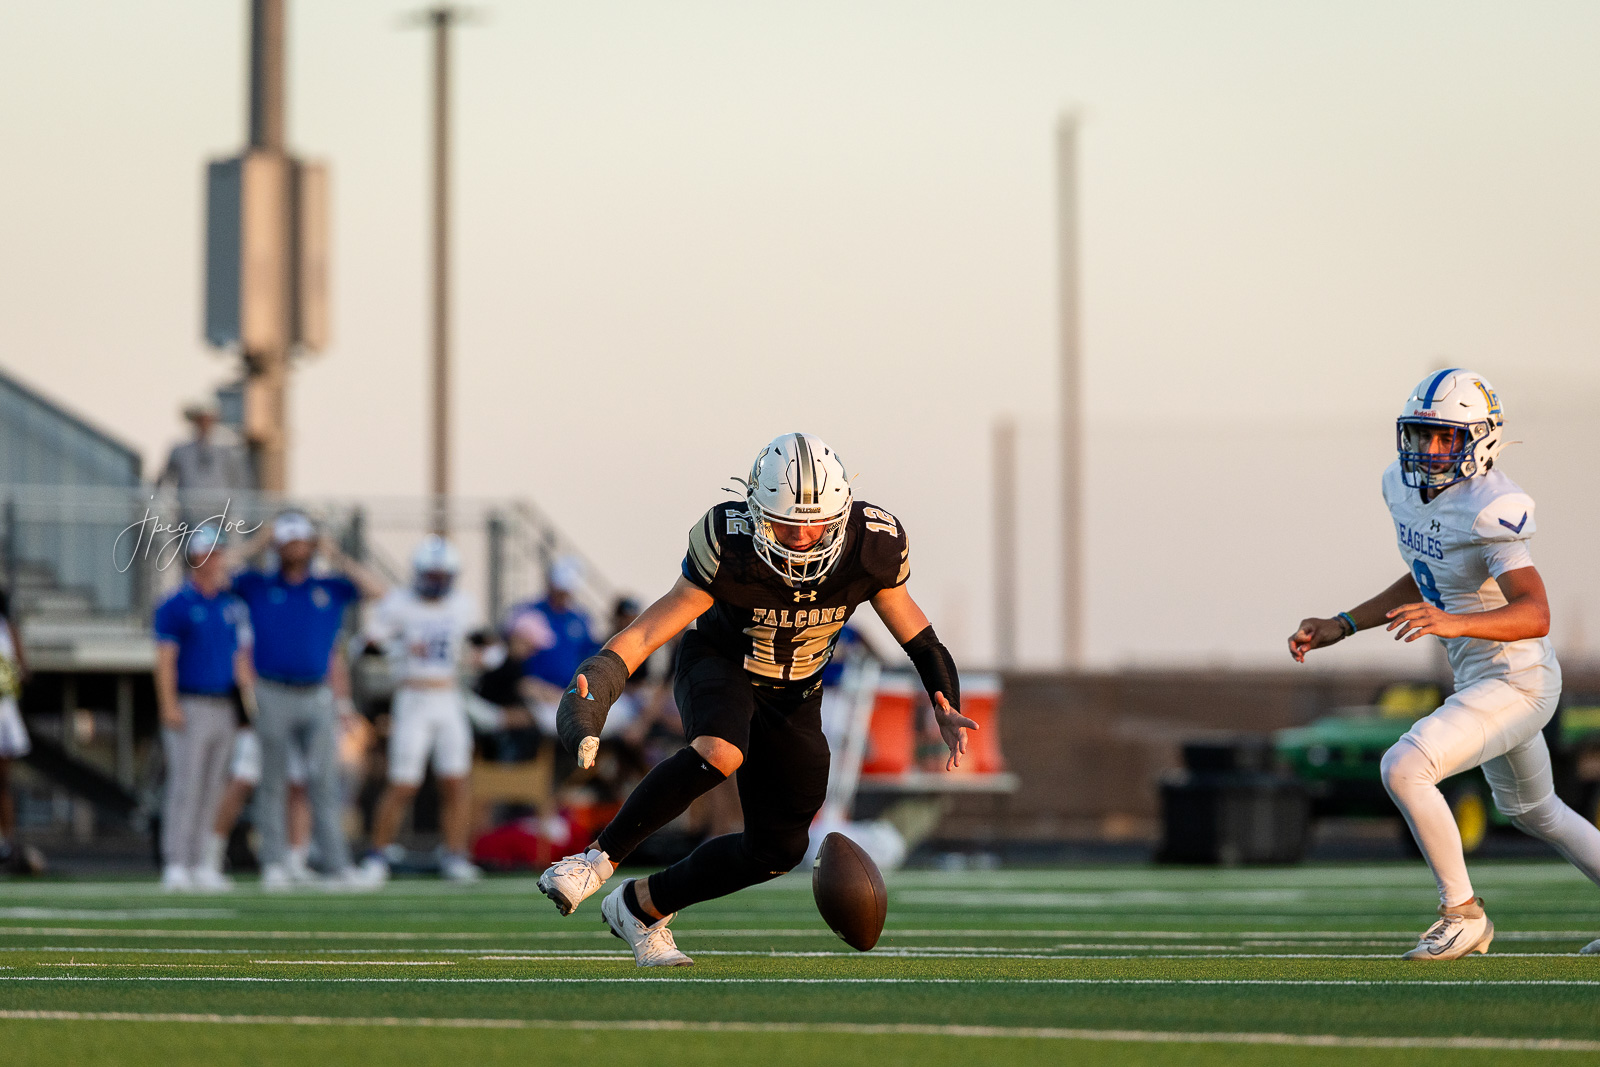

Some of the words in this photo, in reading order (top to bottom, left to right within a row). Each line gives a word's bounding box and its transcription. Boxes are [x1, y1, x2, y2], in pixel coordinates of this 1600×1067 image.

[862, 506, 898, 538] 12
[1398, 522, 1444, 560] EAGLES
[752, 605, 847, 628] FALCONS
[742, 620, 845, 681] 12
